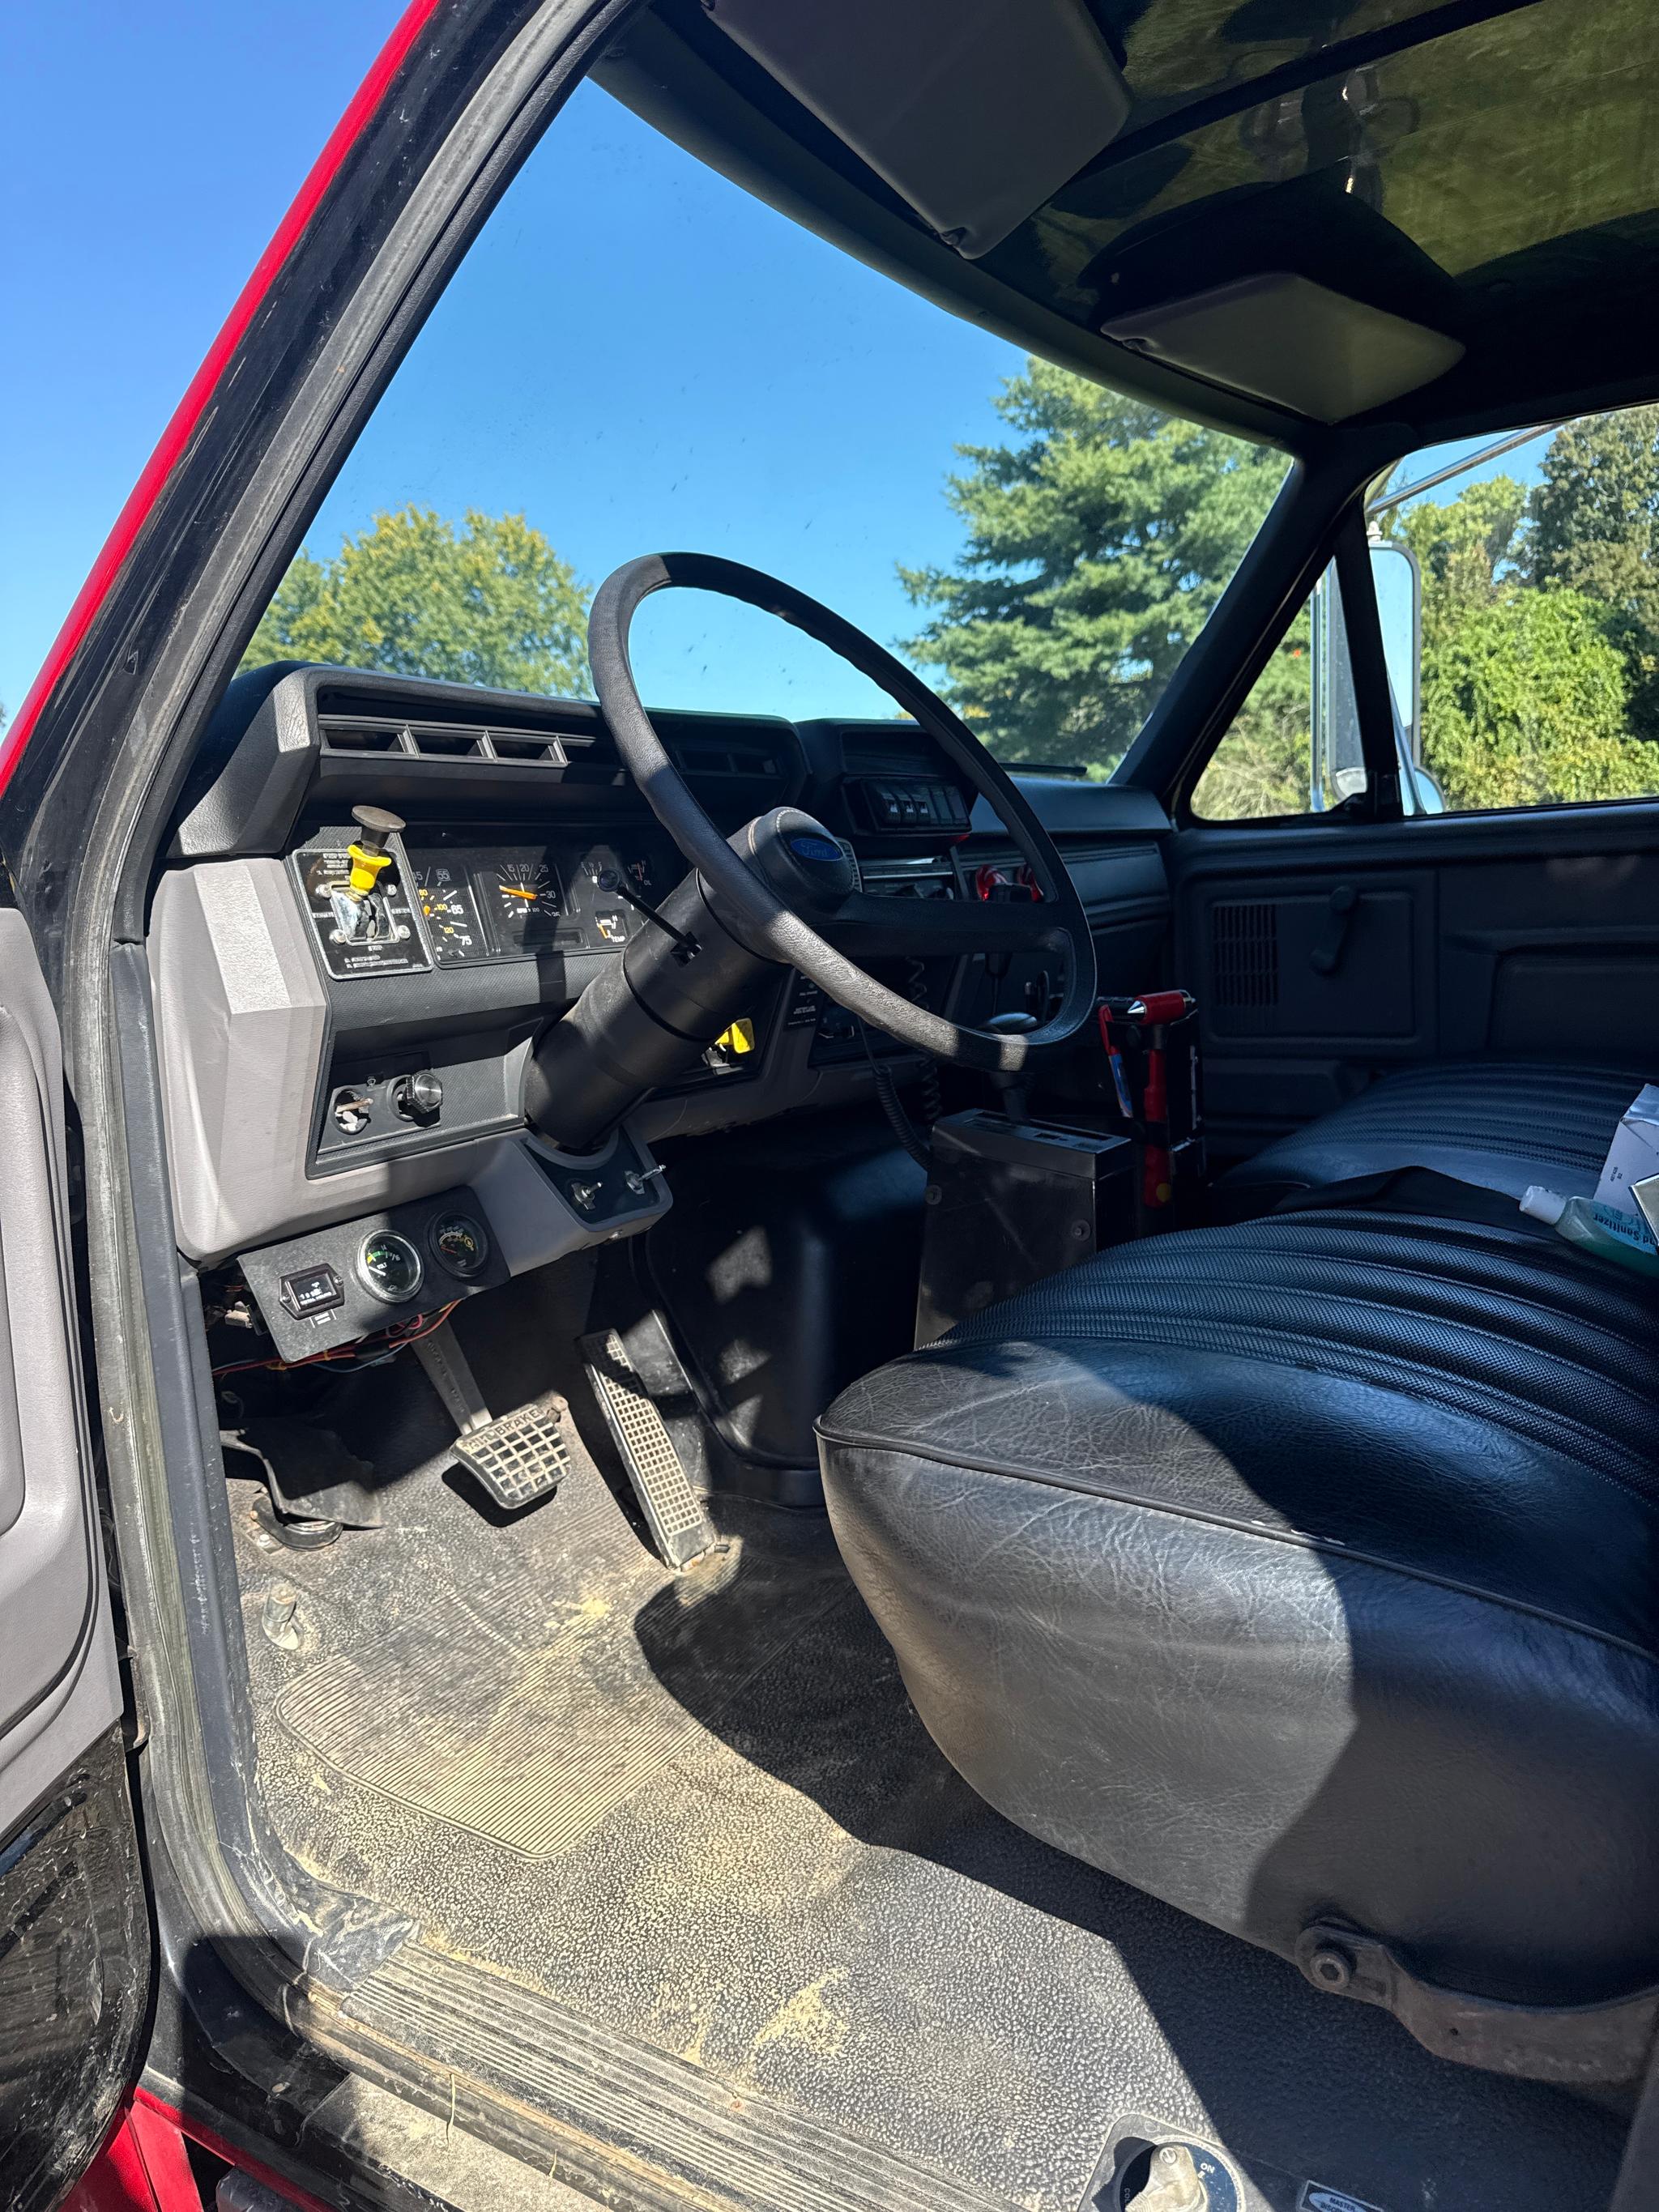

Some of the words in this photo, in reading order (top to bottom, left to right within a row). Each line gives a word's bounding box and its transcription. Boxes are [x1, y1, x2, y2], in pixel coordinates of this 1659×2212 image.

[507, 863, 515, 872] 15
[519, 863, 530, 872] 20
[539, 863, 549, 873] 25
[437, 870, 450, 880] 55
[546, 890, 557, 899] 30
[437, 903, 448, 911] 100
[450, 904, 464, 915] 65
[443, 927, 454, 935] 120
[459, 935, 473, 946] 75
[611, 935, 625, 943] TEMP
[1593, 1213, 1640, 1241] Sanitizer
[494, 1409, 541, 1435] BRAKE
[1200, 2162, 1216, 2174] ON
[1328, 2197, 1356, 2212] MASTER
